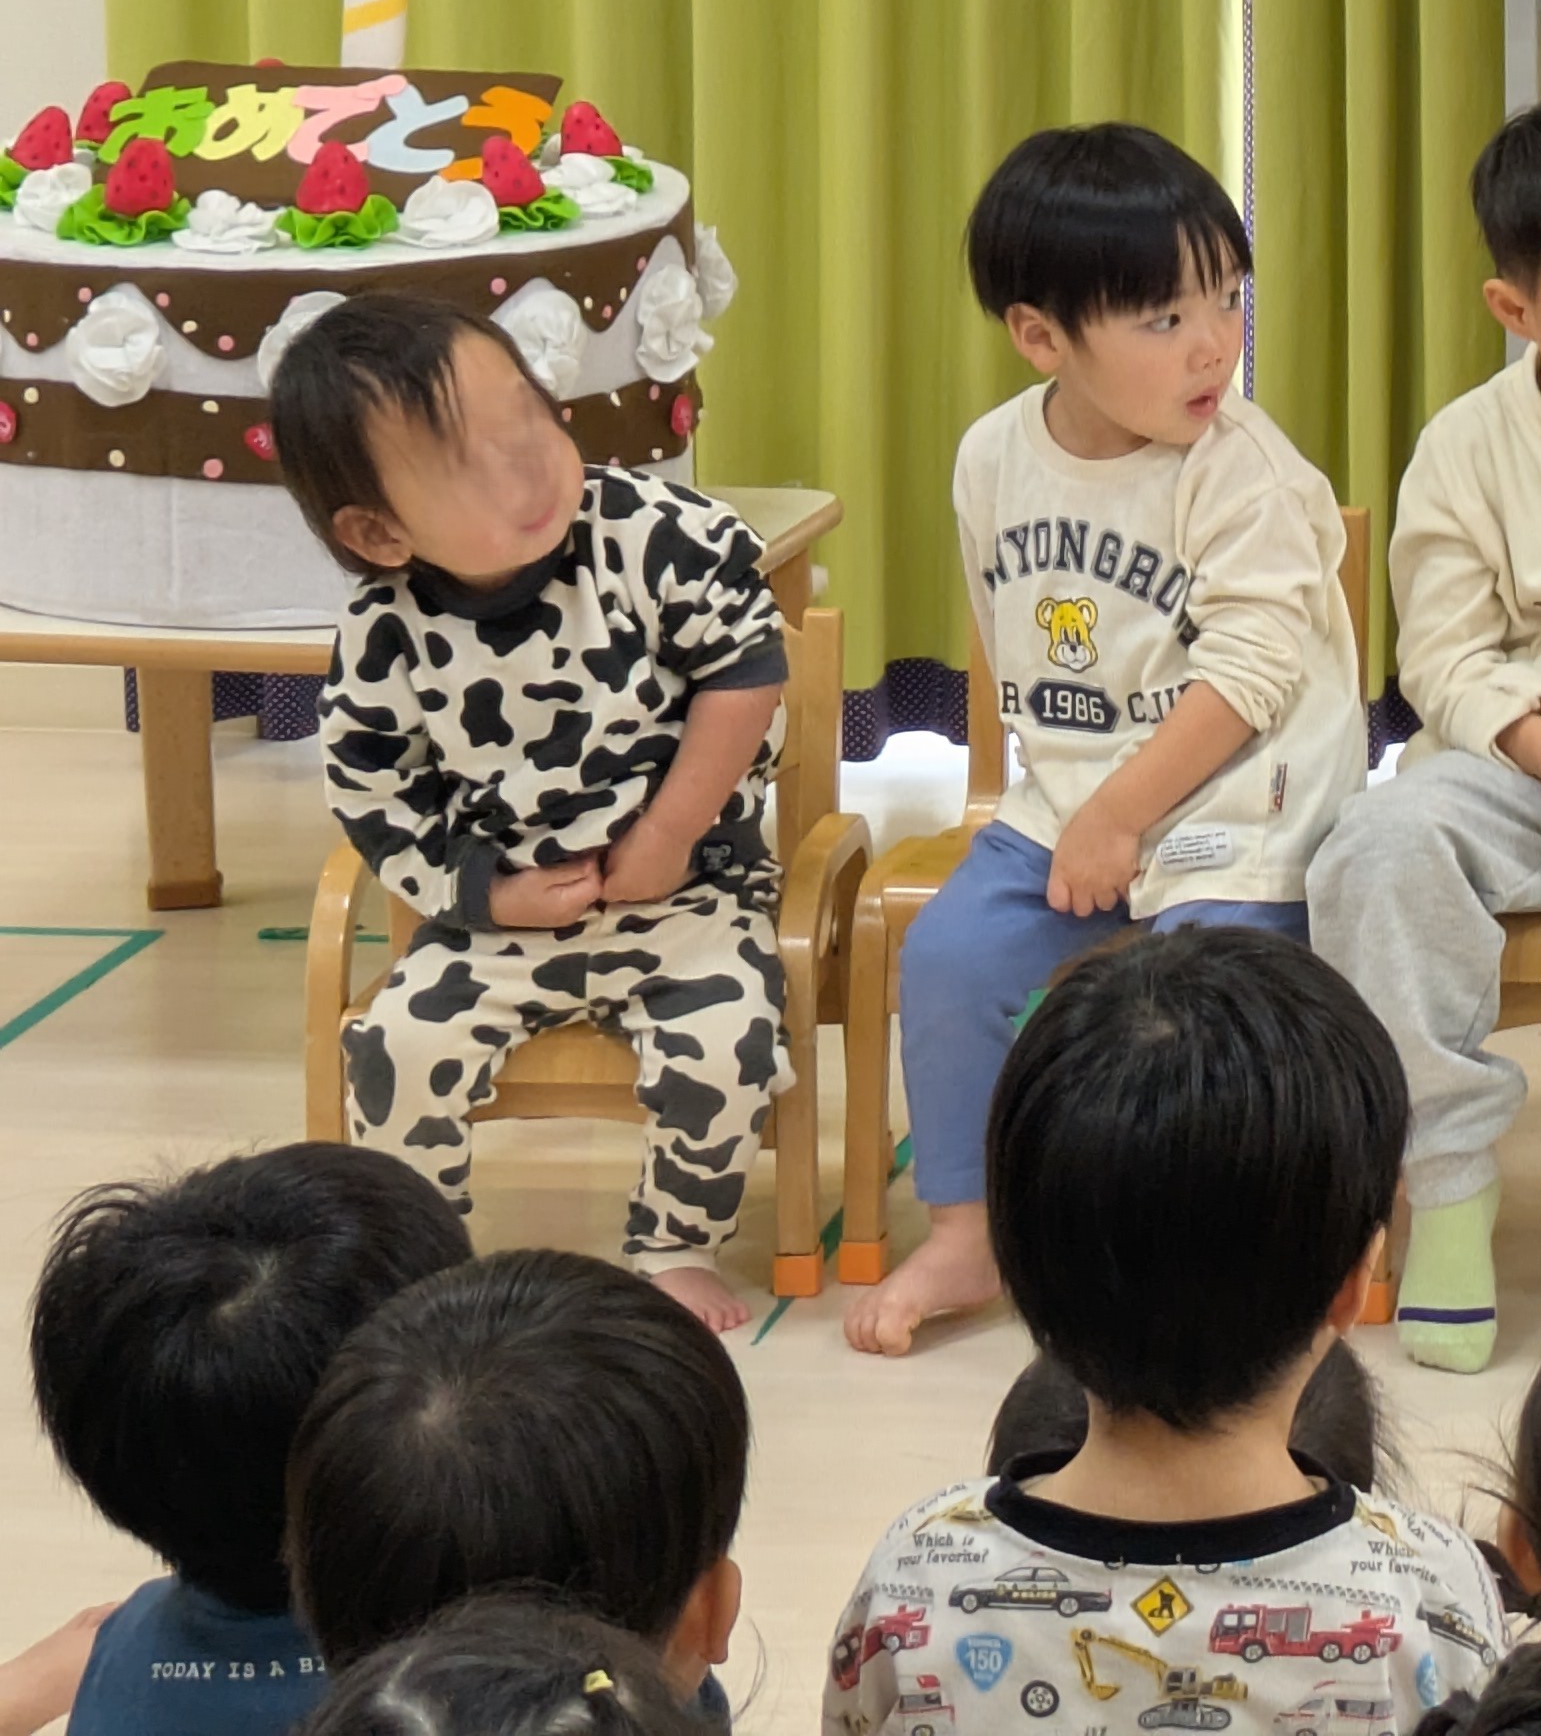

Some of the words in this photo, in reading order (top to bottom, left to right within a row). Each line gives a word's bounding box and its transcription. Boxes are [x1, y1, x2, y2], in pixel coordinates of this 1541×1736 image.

[98, 74, 553, 181] おめでとう
[1041, 687, 1105, 724] 1986
[1350, 1560, 1383, 1576] your
[151, 1662, 216, 1680] TODAY
[228, 1662, 256, 1679] IS
[269, 1660, 286, 1677] A
[299, 1655, 327, 1674] BI
[965, 1648, 1002, 1673] 150
